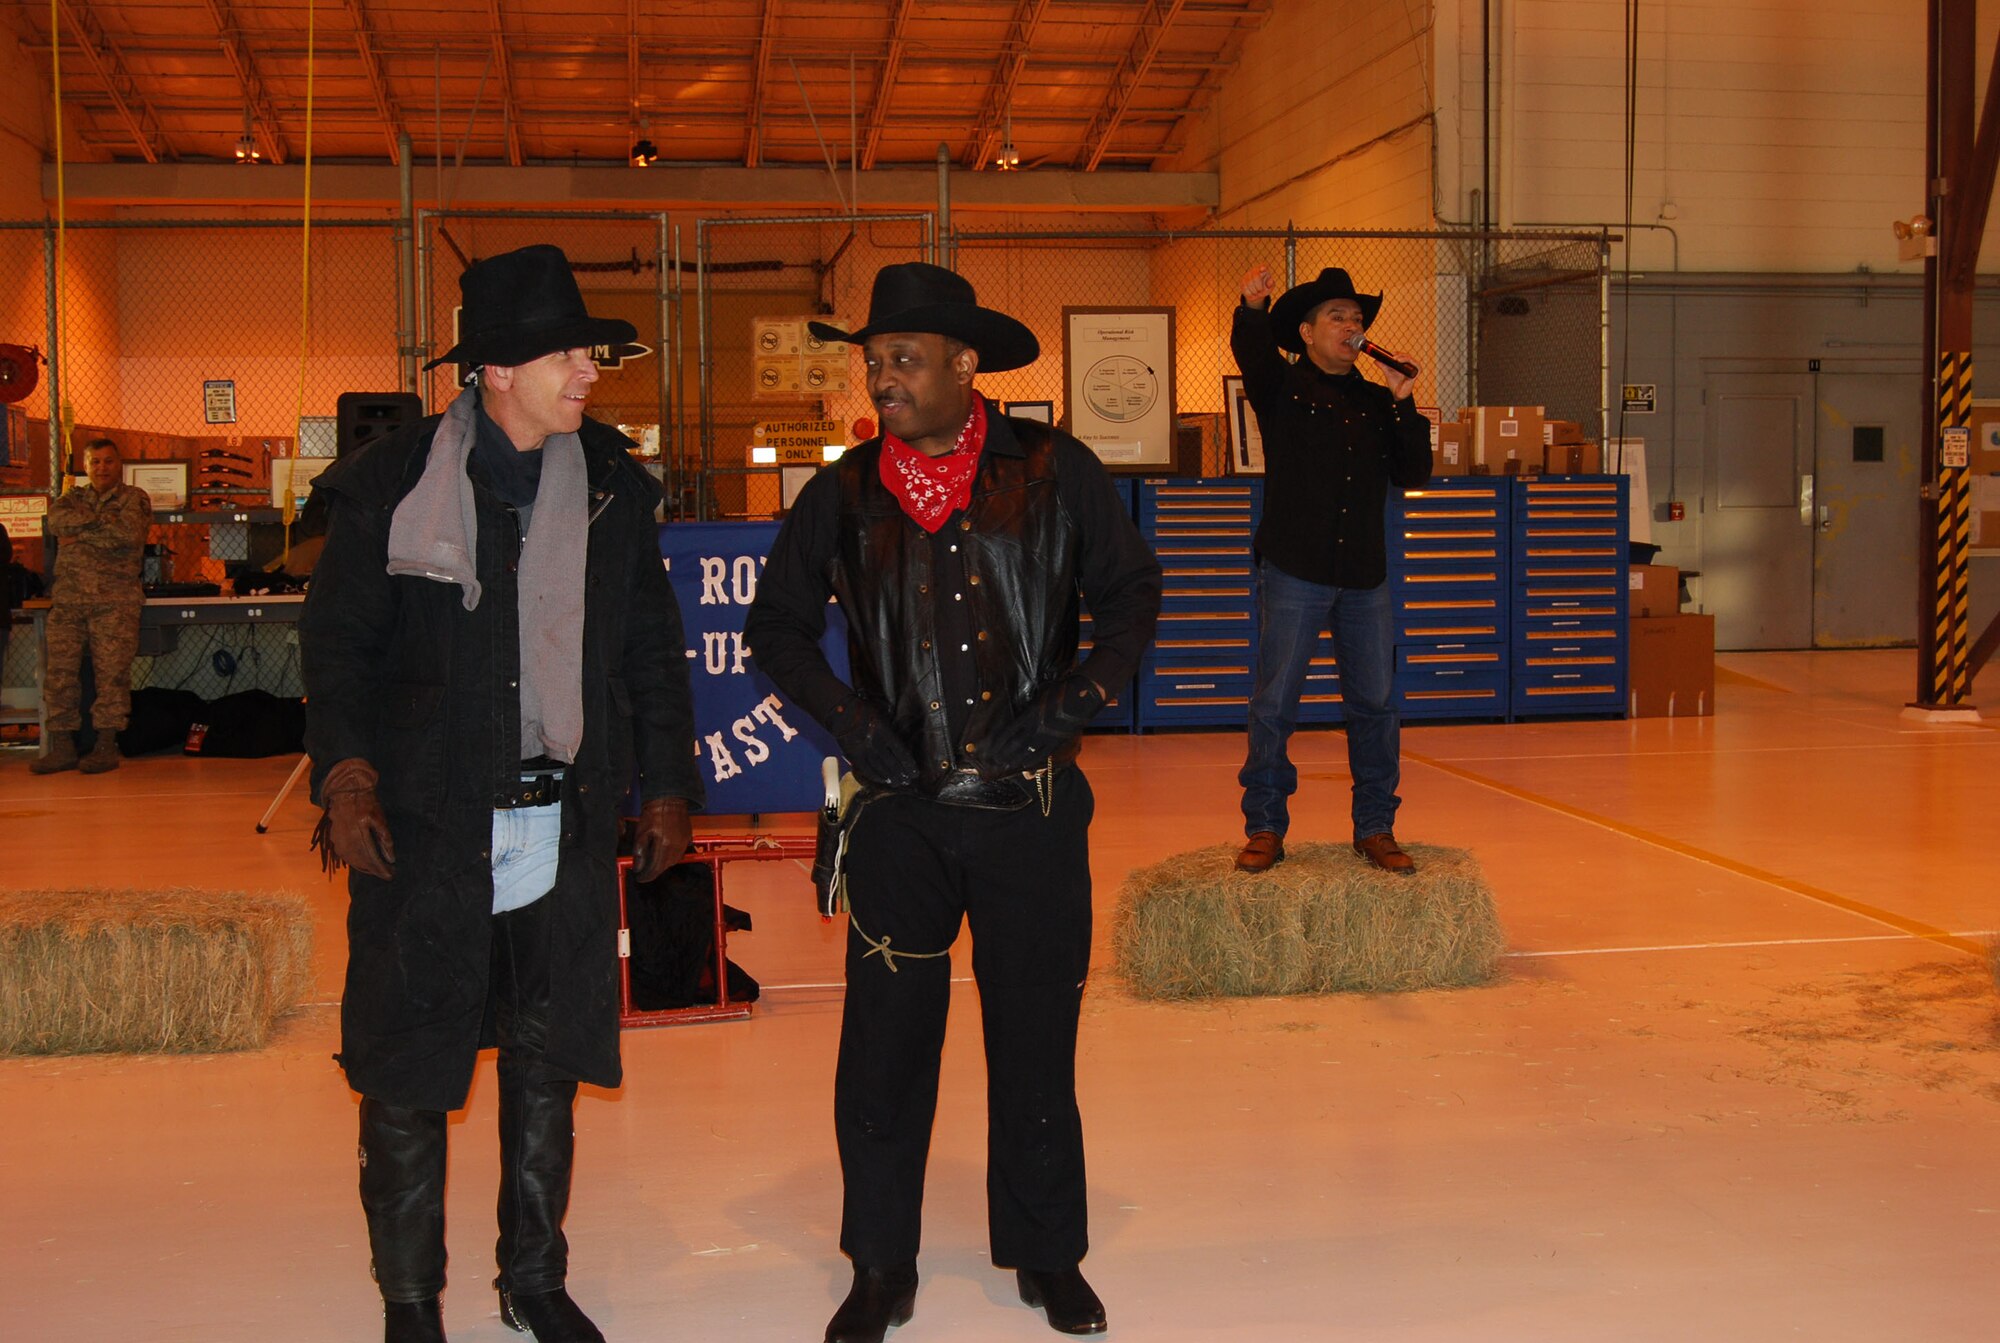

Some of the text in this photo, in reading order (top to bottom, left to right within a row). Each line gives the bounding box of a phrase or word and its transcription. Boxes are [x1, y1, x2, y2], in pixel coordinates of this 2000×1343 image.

[765, 421, 835, 433] AUTHORIZED
[766, 437, 830, 447] PERSONNEL
[785, 450, 813, 459] ONLY
[700, 555, 768, 605] RO
[694, 693, 798, 783] AST
